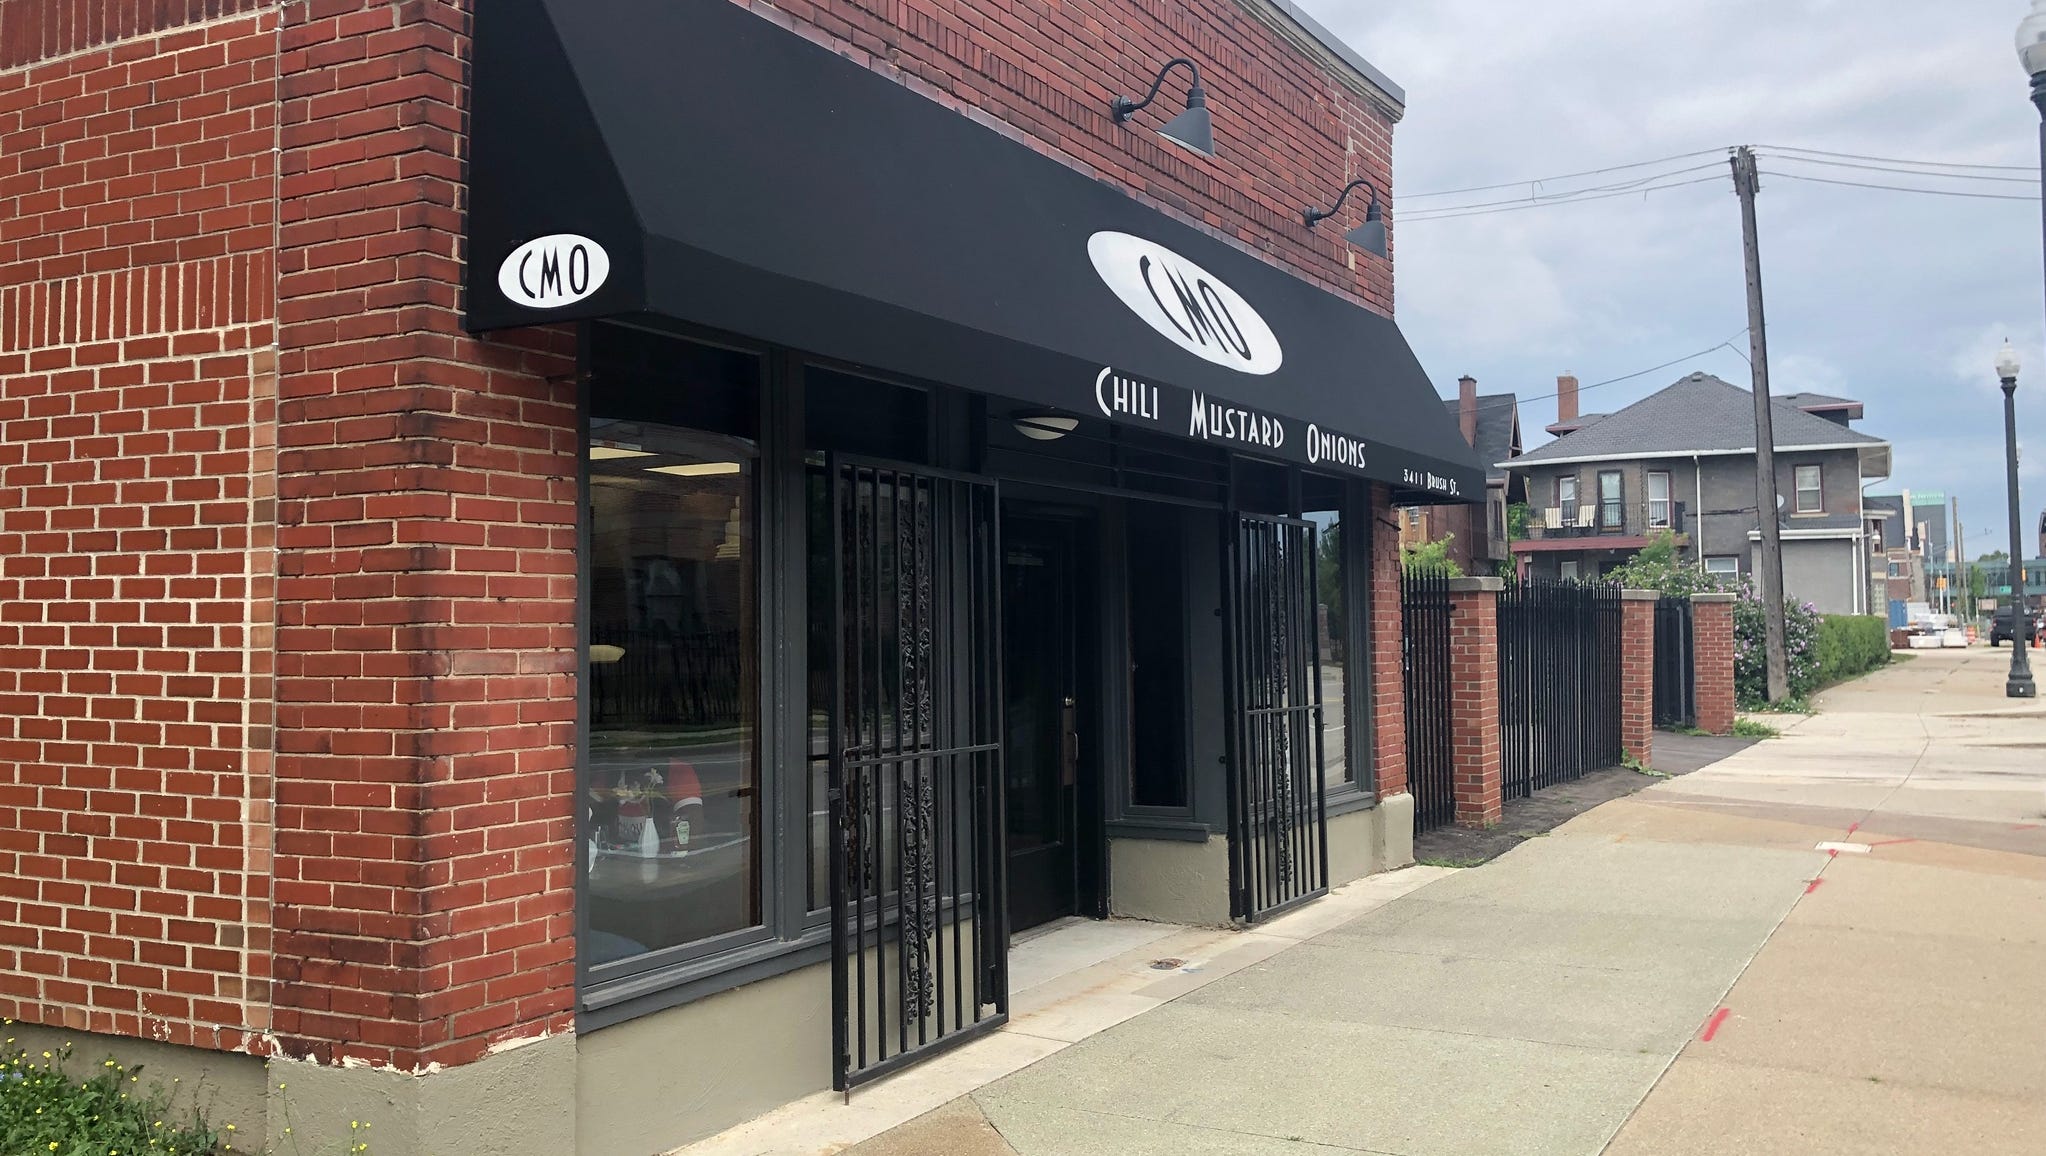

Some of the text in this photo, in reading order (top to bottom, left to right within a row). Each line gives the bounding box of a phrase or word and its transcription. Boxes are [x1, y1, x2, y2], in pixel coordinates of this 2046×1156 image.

[518, 243, 589, 300] CMO
[1139, 254, 1252, 361] CMO
[1095, 366, 1366, 469] CHILI MUSTARD ONIONS
[1403, 468, 1460, 496] 3411 BRUSH ST.
